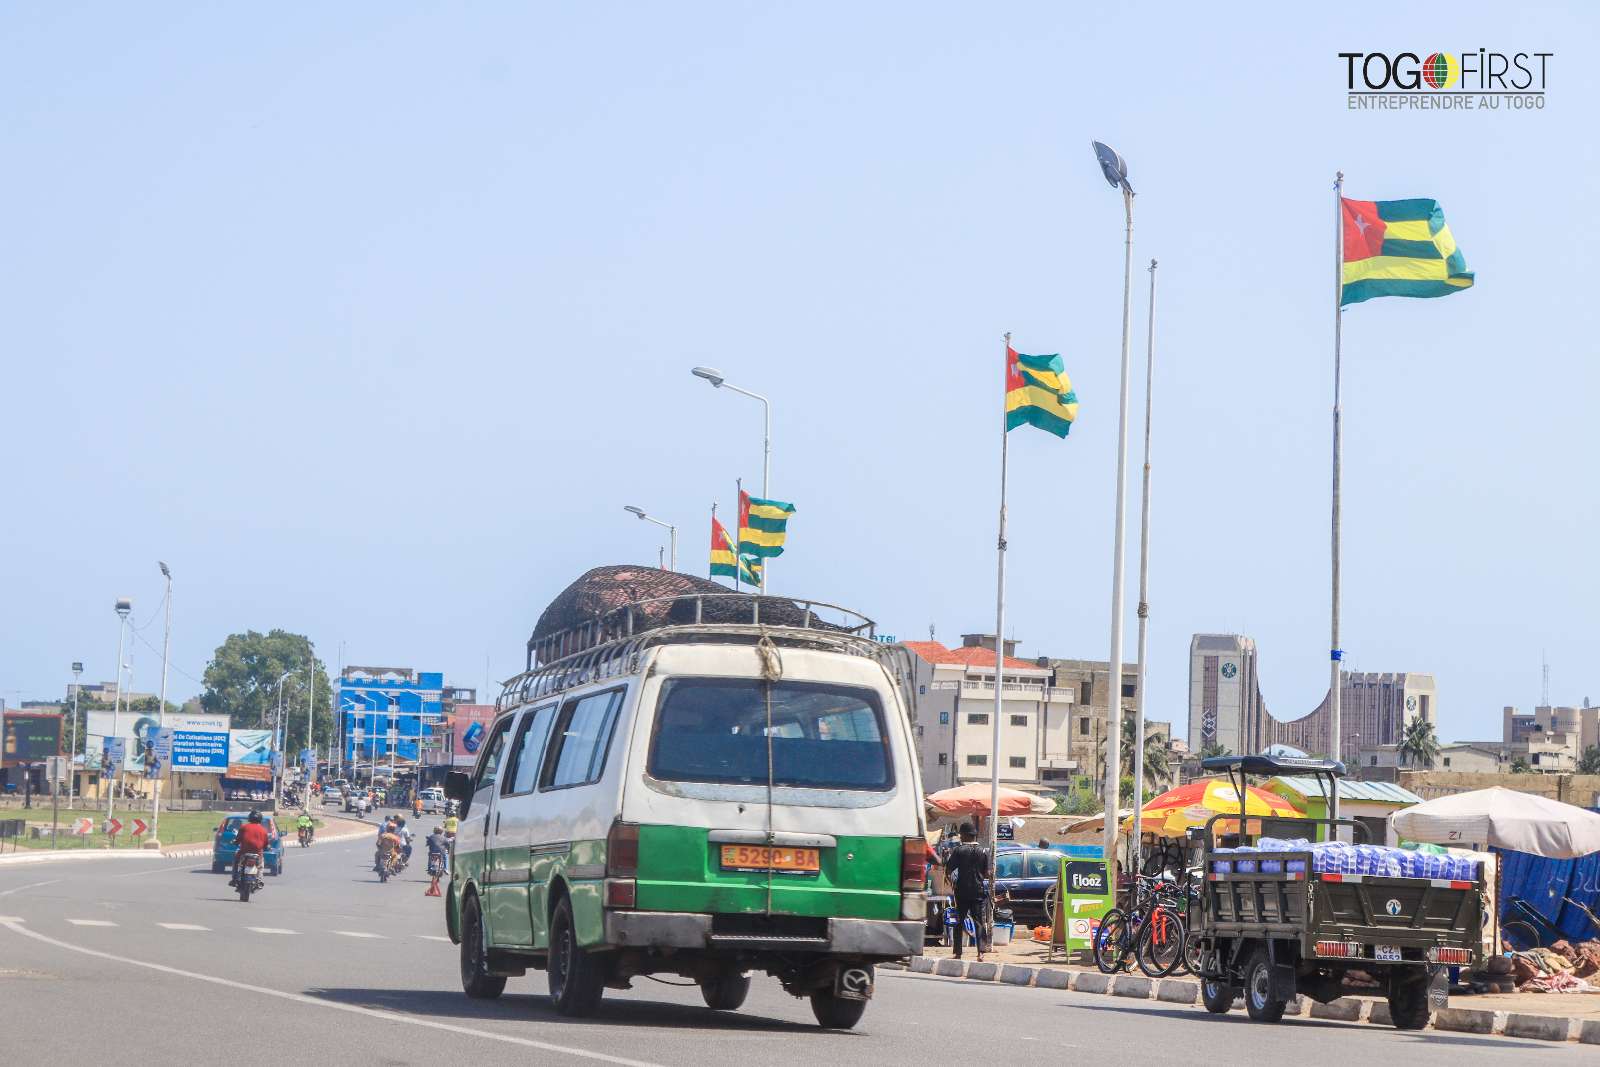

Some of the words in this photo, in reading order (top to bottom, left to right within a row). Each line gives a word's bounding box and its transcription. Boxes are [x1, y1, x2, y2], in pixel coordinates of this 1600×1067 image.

[177, 755, 189, 763] en
[190, 755, 210, 765] ligne
[739, 847, 783, 865] 5290
[794, 850, 817, 866] BA
[1382, 946, 1395, 954] CZ
